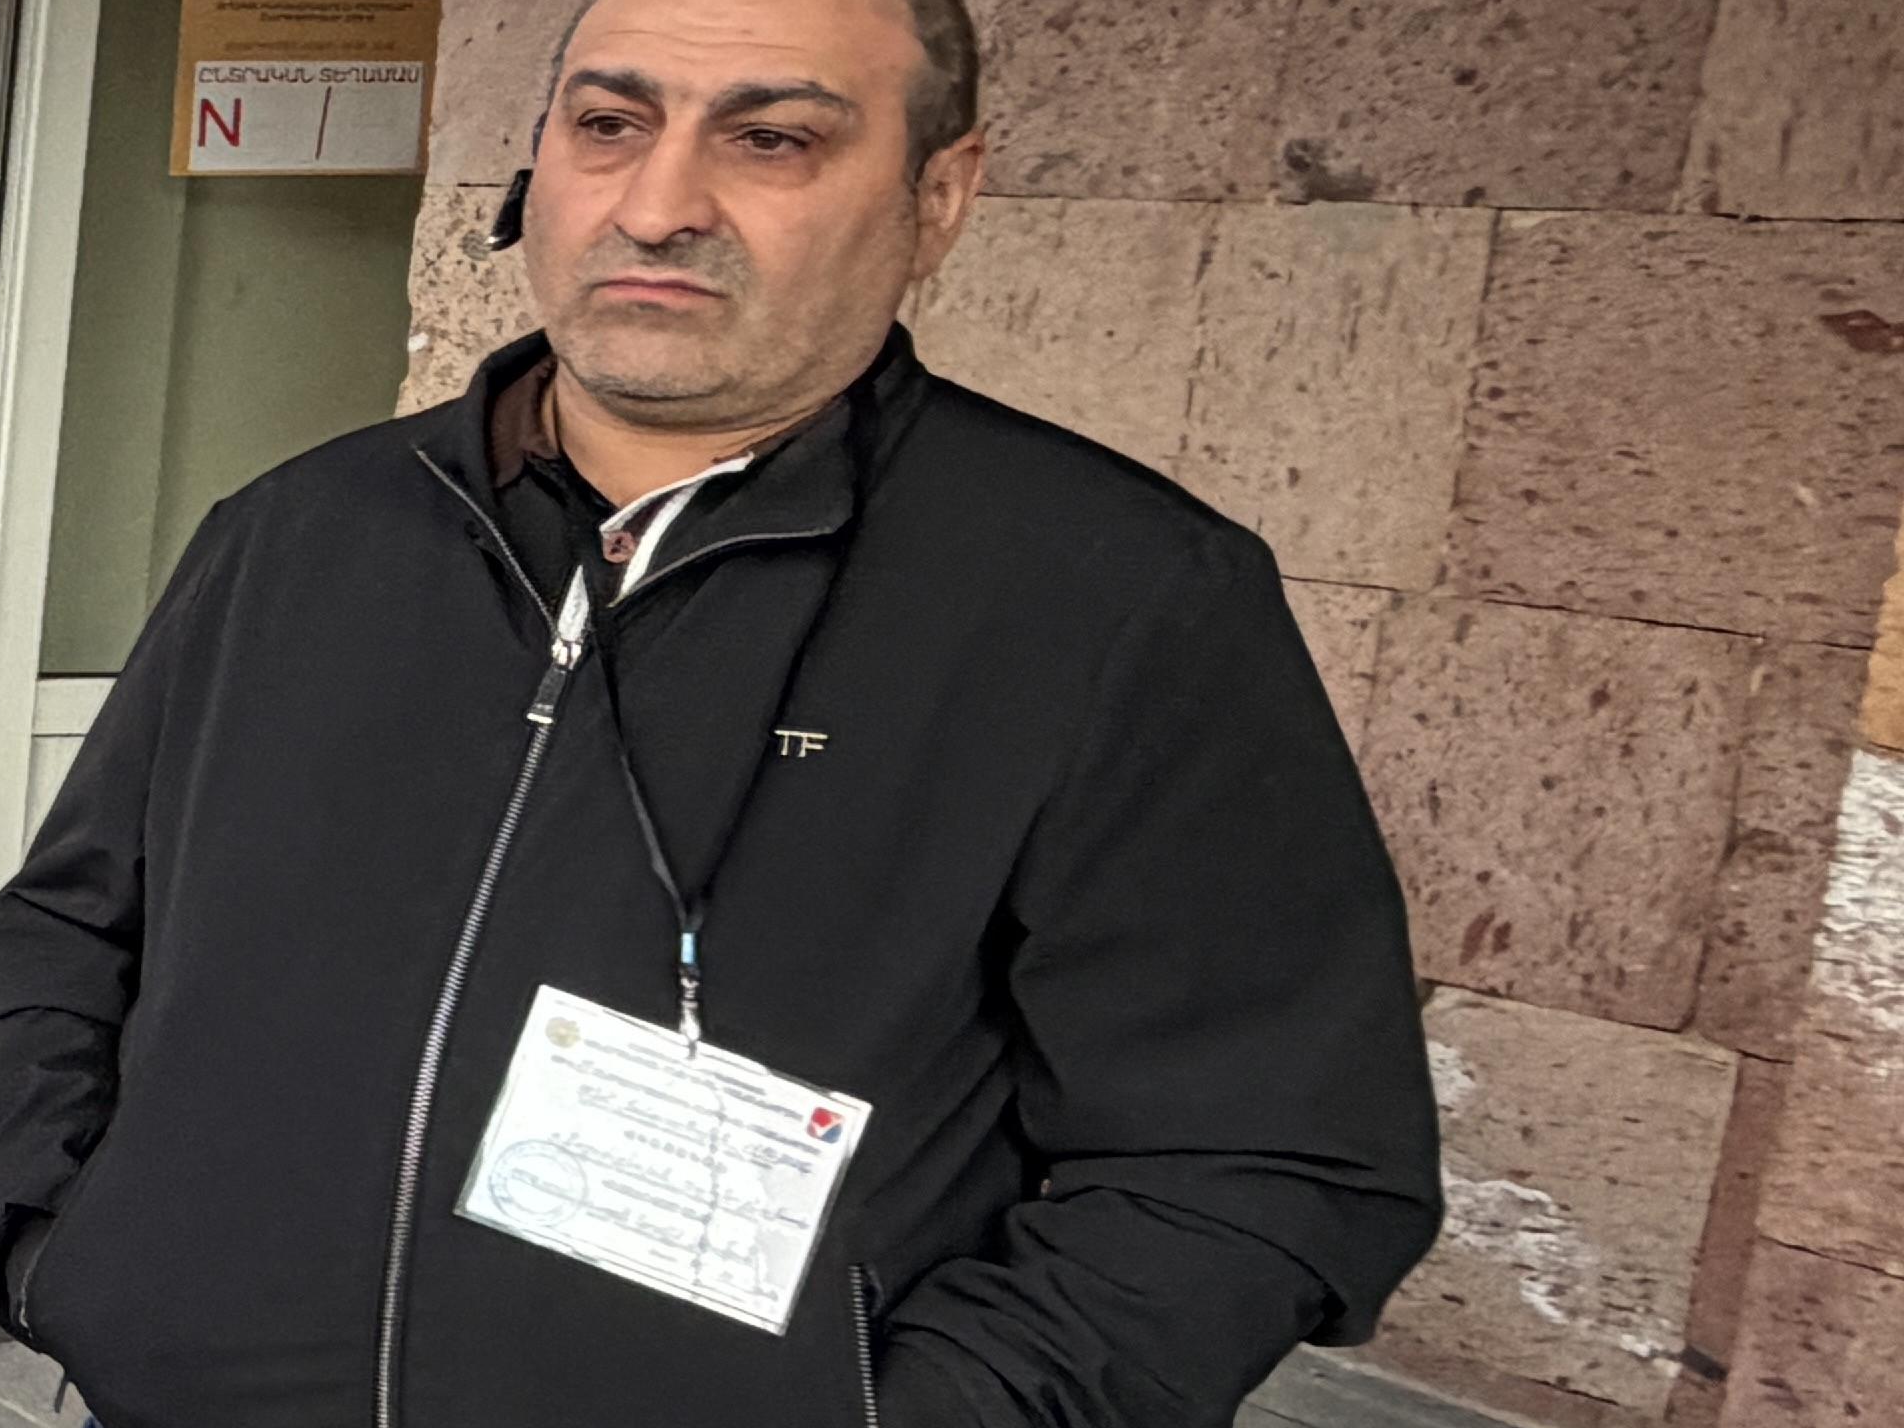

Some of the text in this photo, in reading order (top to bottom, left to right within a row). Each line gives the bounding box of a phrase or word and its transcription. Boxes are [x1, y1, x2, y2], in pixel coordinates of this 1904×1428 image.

[198, 67, 420, 84] ԸՆՏՐԱԿԱՆ ՏԵՂԱՄԱՍ
[197, 97, 241, 148] N
